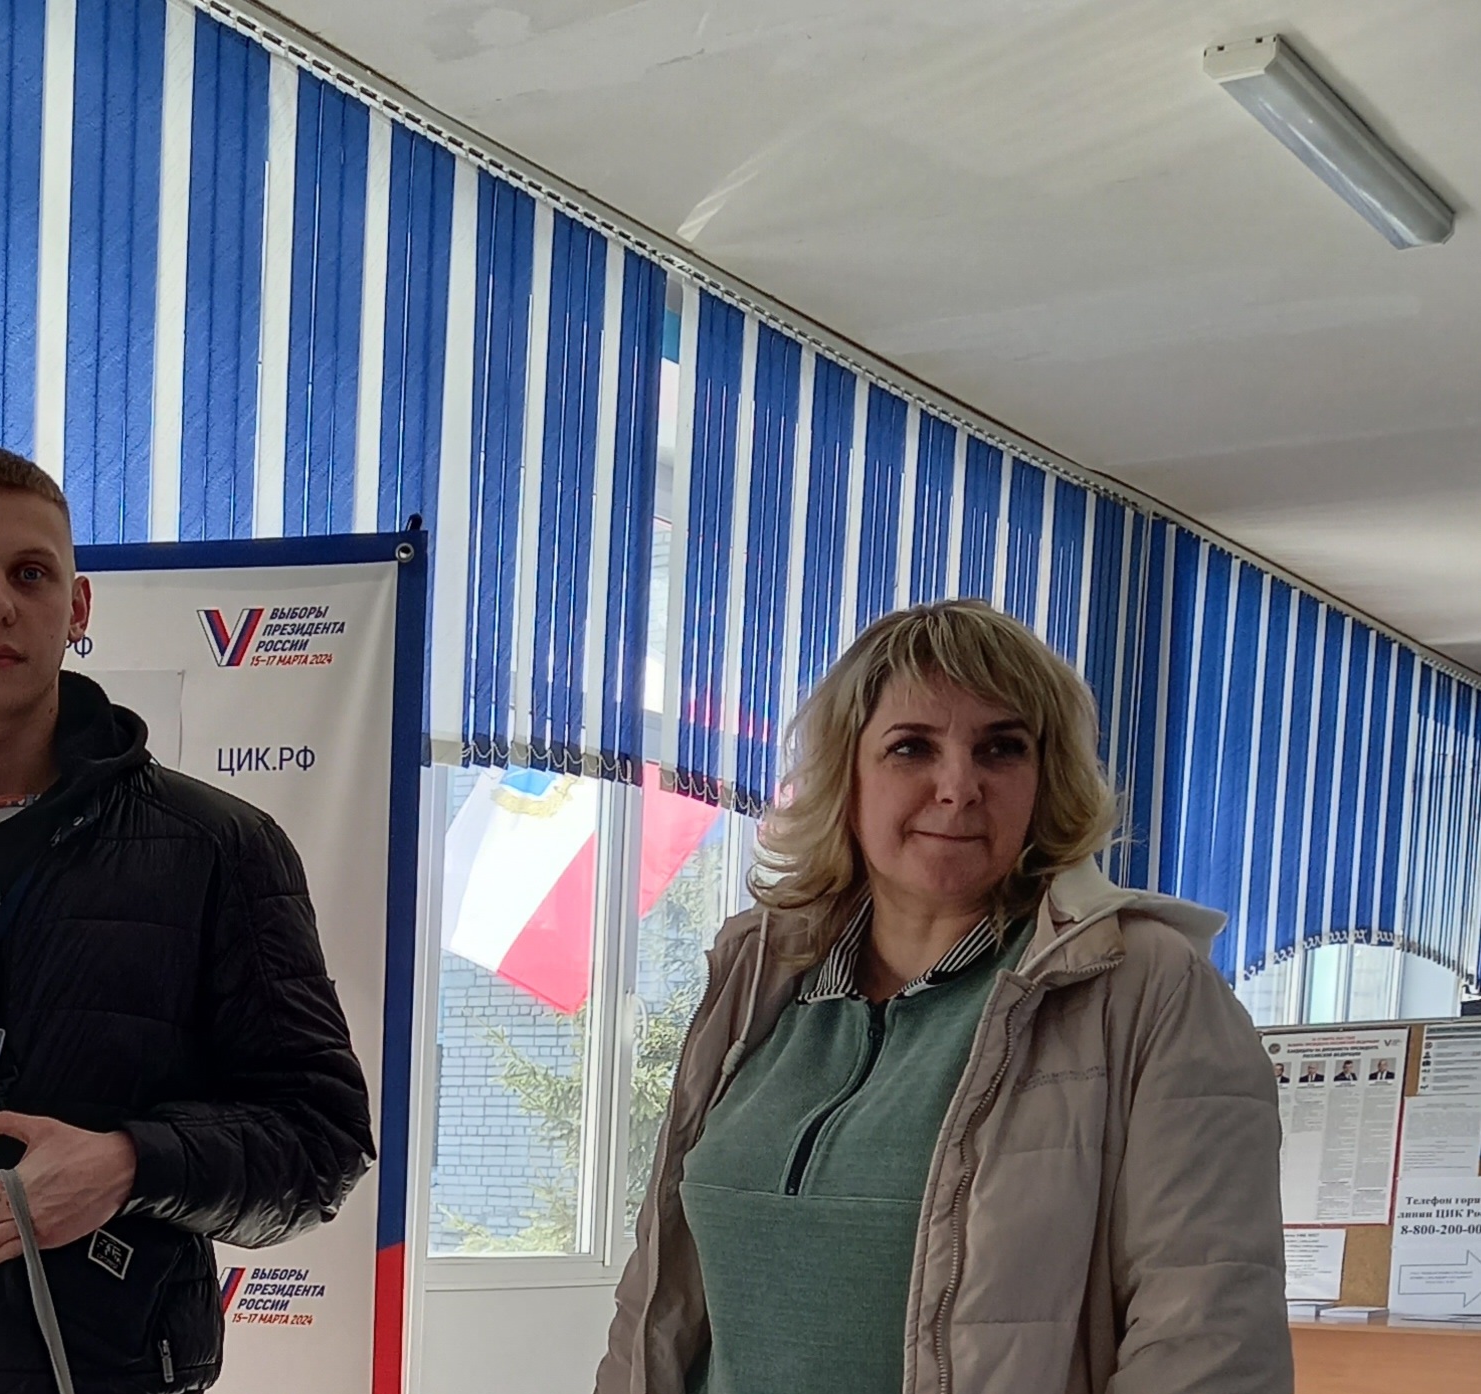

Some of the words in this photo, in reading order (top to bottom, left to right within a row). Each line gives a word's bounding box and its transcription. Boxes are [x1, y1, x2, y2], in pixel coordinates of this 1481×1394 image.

[270, 606, 329, 619] ВЫБОРЫ
[262, 622, 345, 636] ПРЕЗИДЕНТА
[255, 639, 309, 652] РОССИИ
[277, 654, 308, 665] МАРТА
[310, 653, 332, 665] 2024
[218, 746, 315, 776] ЦИК.РФ
[1406, 1196, 1452, 1207] Телефон
[1436, 1209, 1464, 1219] ЦИК
[251, 1268, 309, 1281] ВЫБОРЫ
[244, 1284, 326, 1297] ПРЕЗИДЕНТА
[237, 1299, 290, 1311] РОССИИ
[258, 1314, 289, 1324] МАРТА
[290, 1315, 313, 1325] 2024
